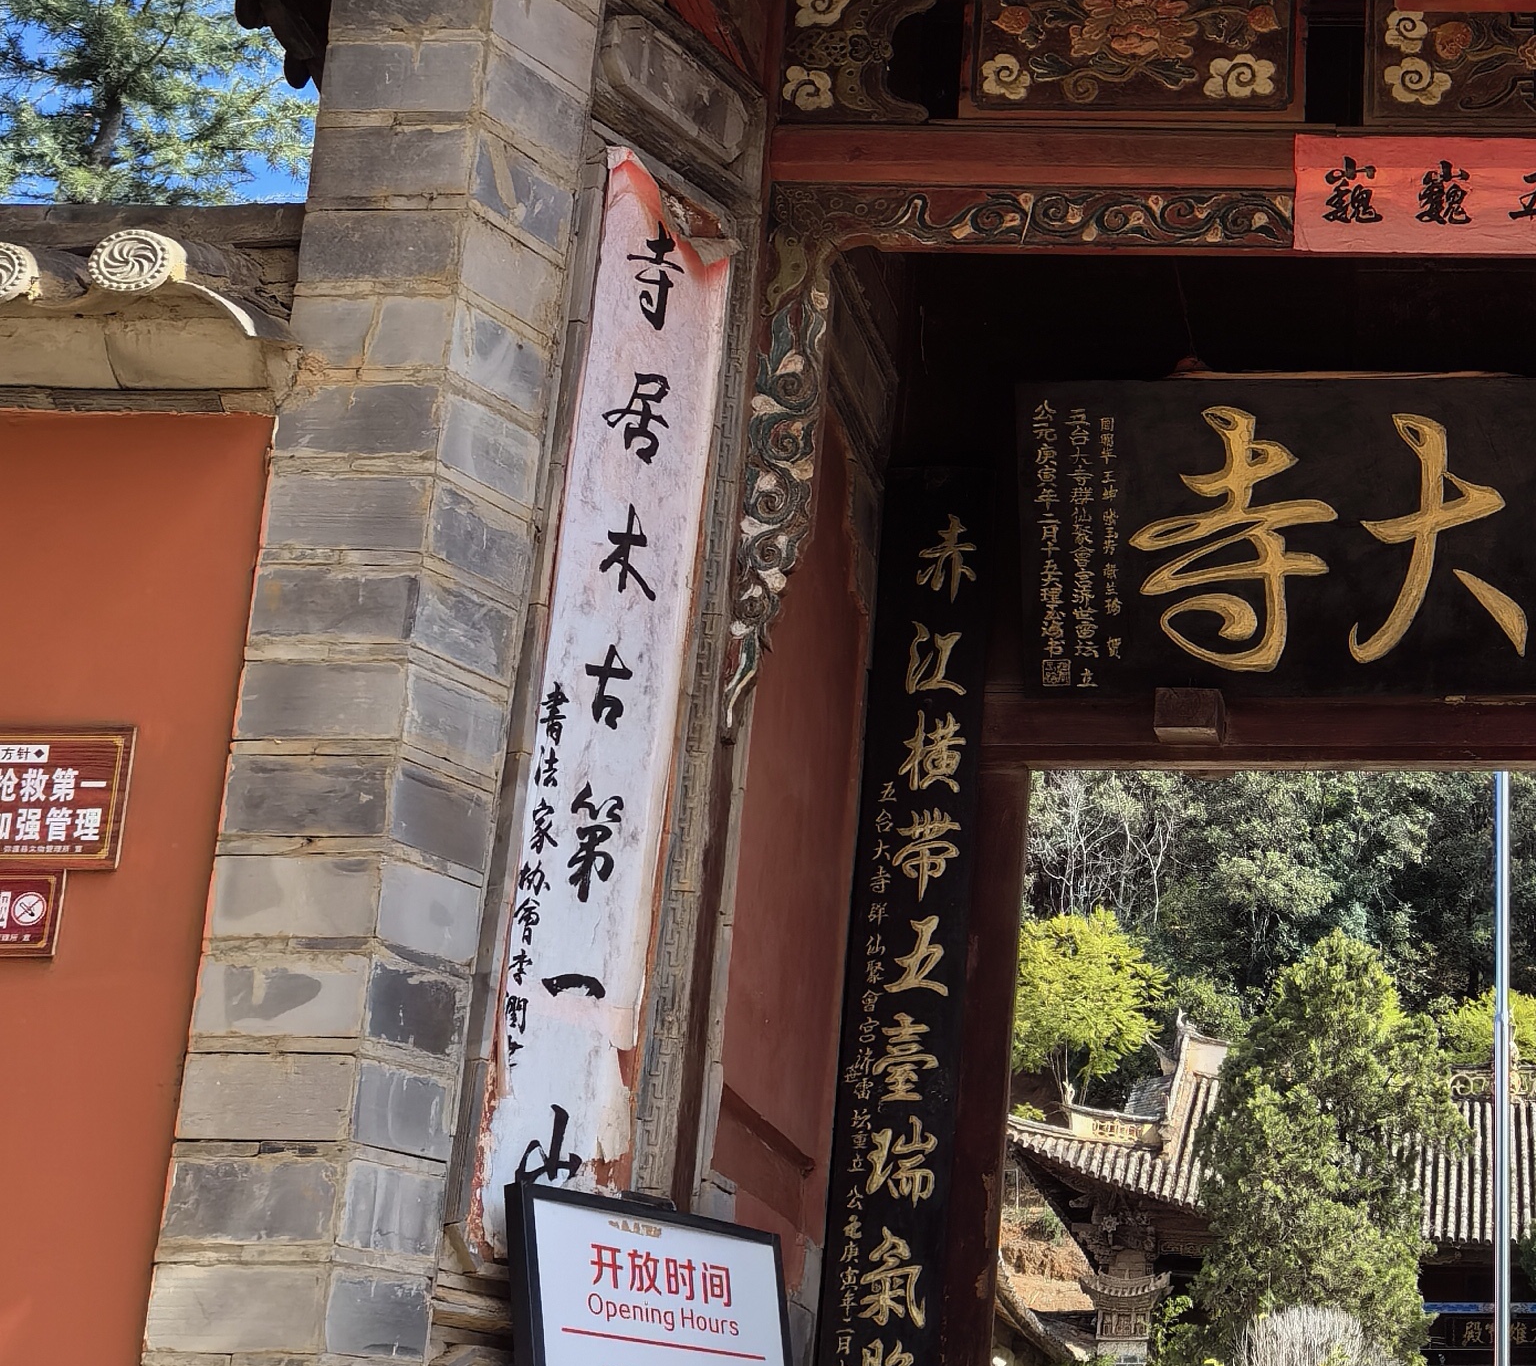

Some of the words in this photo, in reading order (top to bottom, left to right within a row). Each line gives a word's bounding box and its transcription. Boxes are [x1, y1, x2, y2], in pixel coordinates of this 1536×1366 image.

[1, 747, 31, 760] 方针
[590, 1242, 732, 1308] 开放时间
[587, 1292, 675, 1332] Opening
[681, 1307, 740, 1336] Hours
